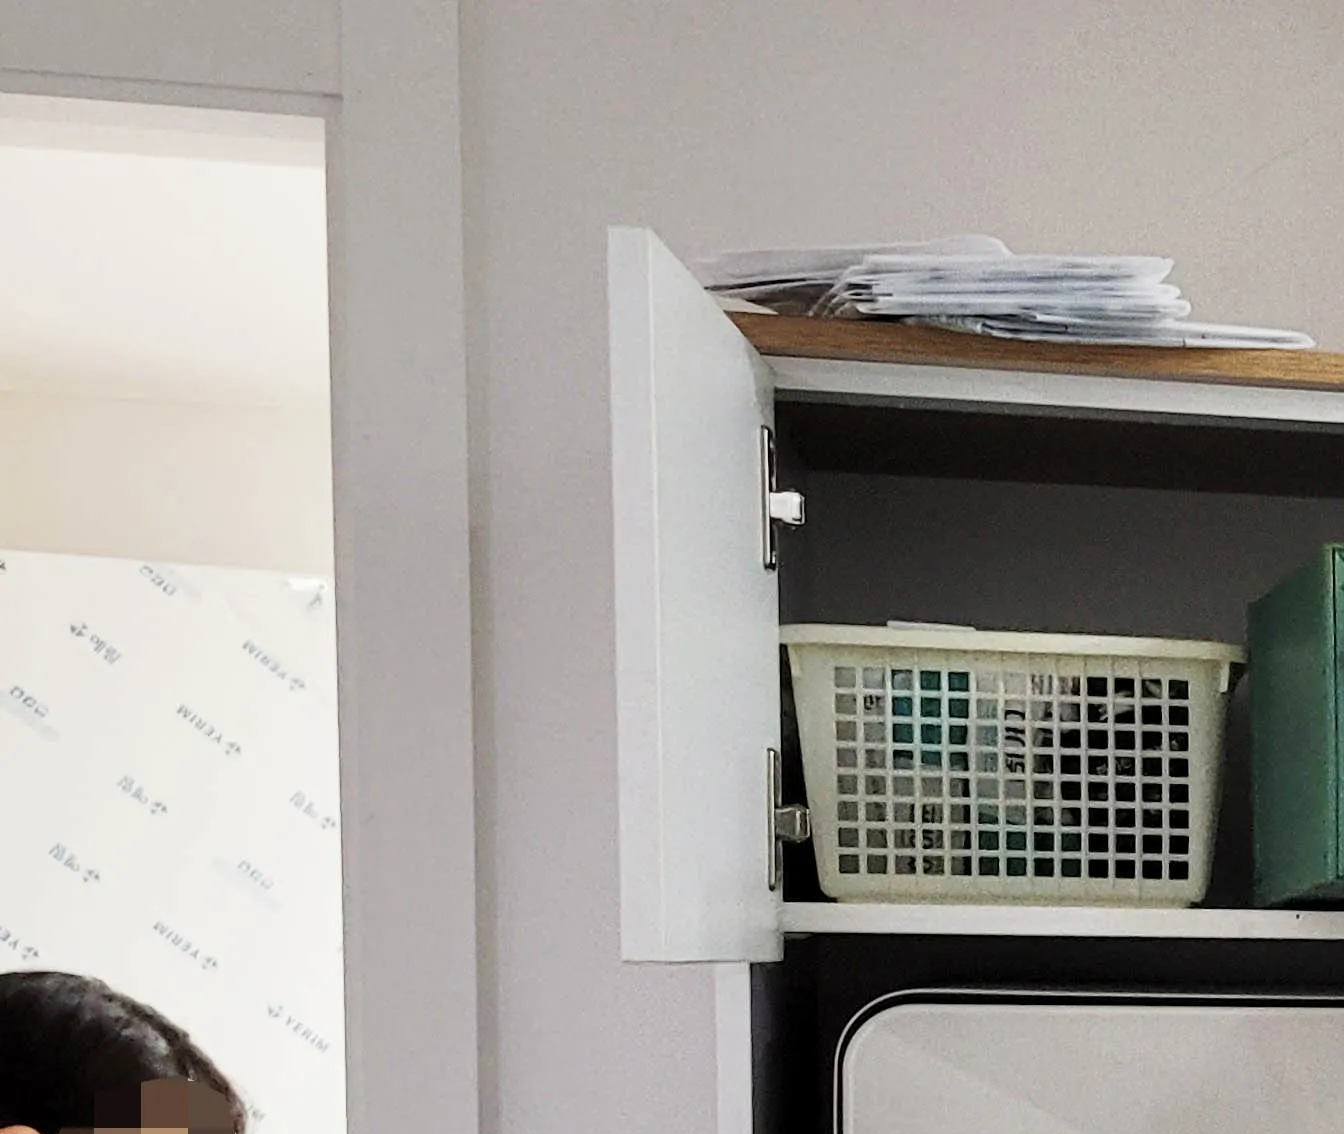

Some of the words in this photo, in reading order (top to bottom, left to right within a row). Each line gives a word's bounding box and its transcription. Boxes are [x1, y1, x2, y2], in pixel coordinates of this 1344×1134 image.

[176, 702, 223, 746] YERIM
[152, 920, 200, 960] YERIM
[284, 1014, 331, 1053] YERIM
